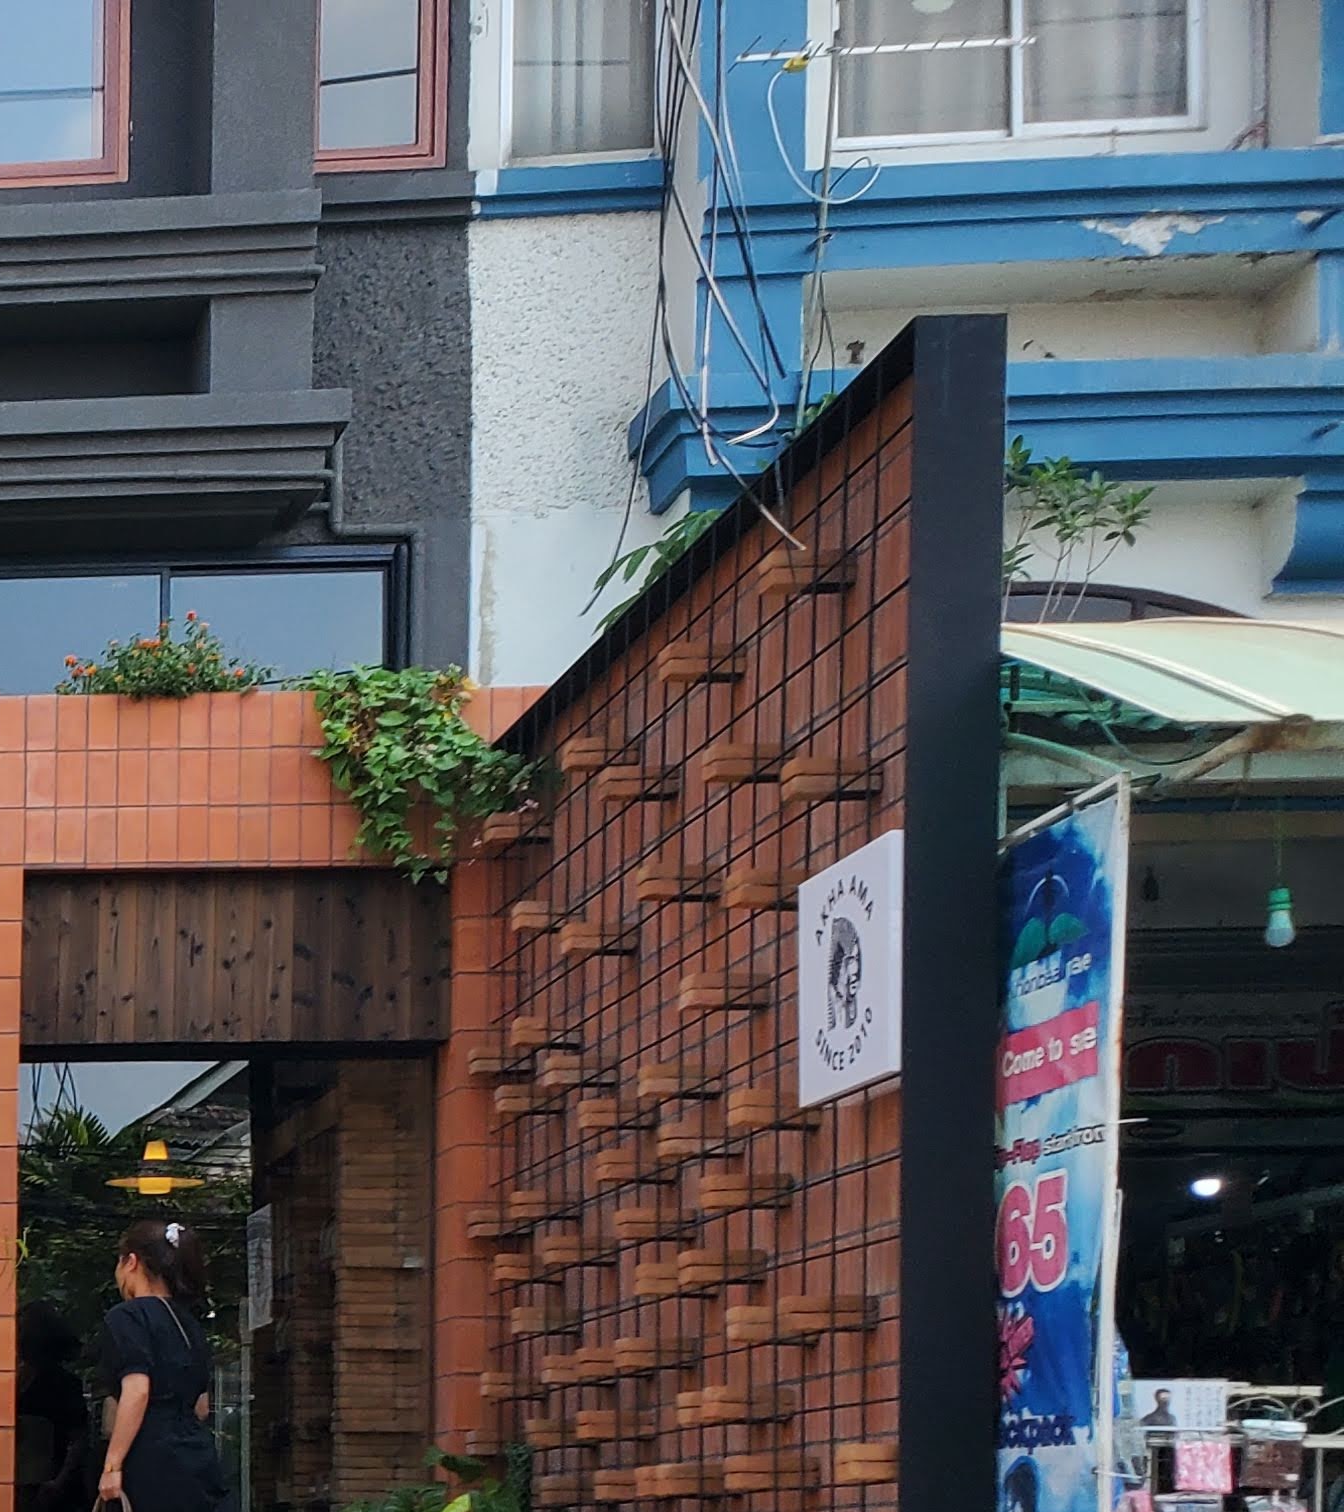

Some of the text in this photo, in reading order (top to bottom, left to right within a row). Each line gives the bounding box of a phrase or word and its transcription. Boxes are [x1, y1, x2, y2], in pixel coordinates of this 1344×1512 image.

[815, 875, 875, 946] AKHA AMA
[815, 1006, 873, 1071] SINCE 2010
[1002, 1046, 1045, 1078] Come
[1047, 1037, 1063, 1062] to
[996, 1169, 1069, 1298] 65
